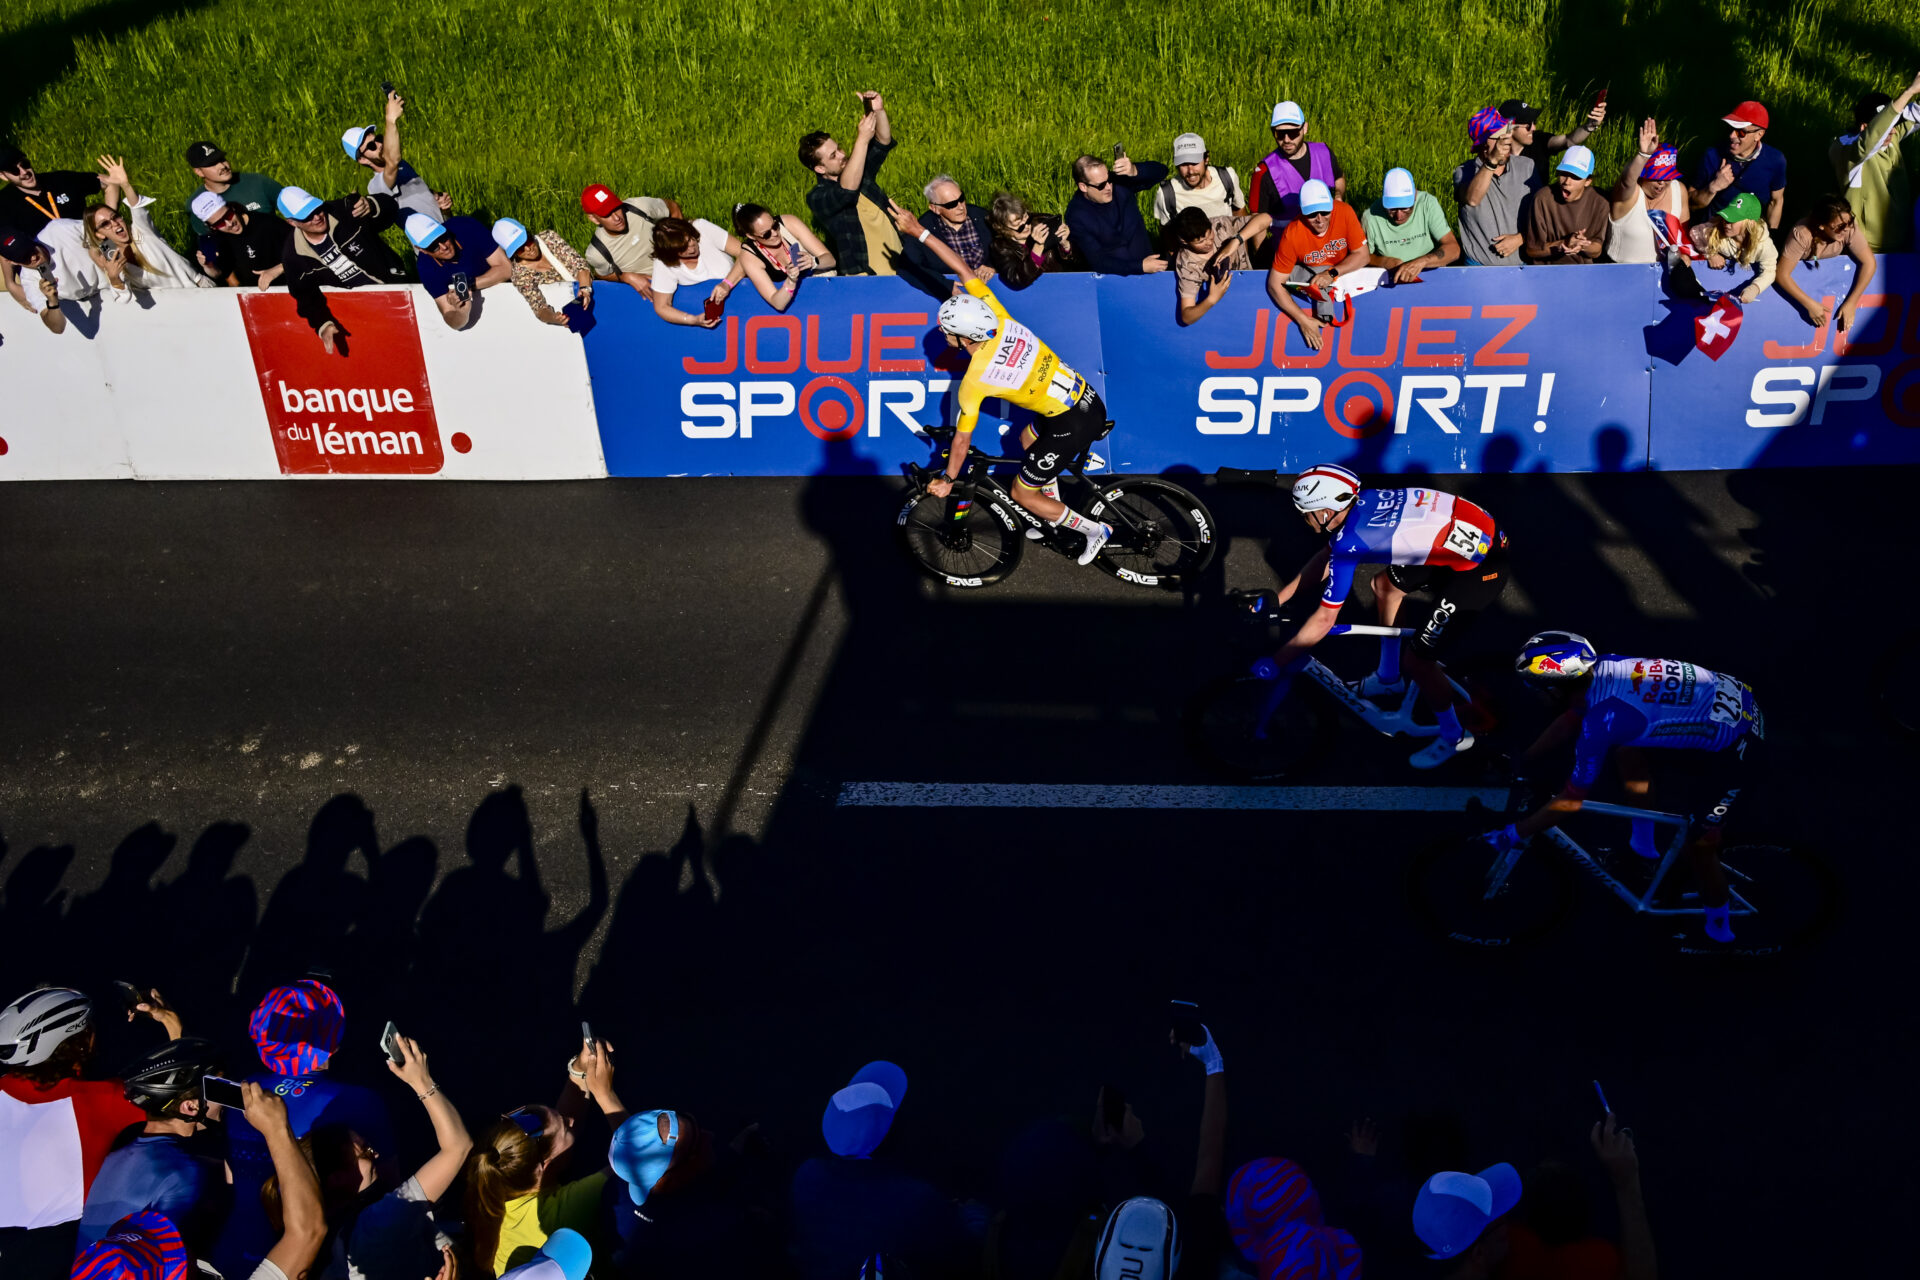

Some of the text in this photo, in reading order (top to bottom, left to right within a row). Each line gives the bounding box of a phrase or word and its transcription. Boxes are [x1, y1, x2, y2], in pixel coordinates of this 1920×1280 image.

[995, 335, 1017, 366] UAE
[1205, 304, 1538, 369] JOUEZ
[278, 381, 415, 421] banque
[1051, 379, 1071, 394] 1
[287, 423, 424, 455] du léman
[993, 489, 1042, 528] COLNAGO
[1449, 526, 1480, 553] 54
[1420, 598, 1457, 648] INEOS
